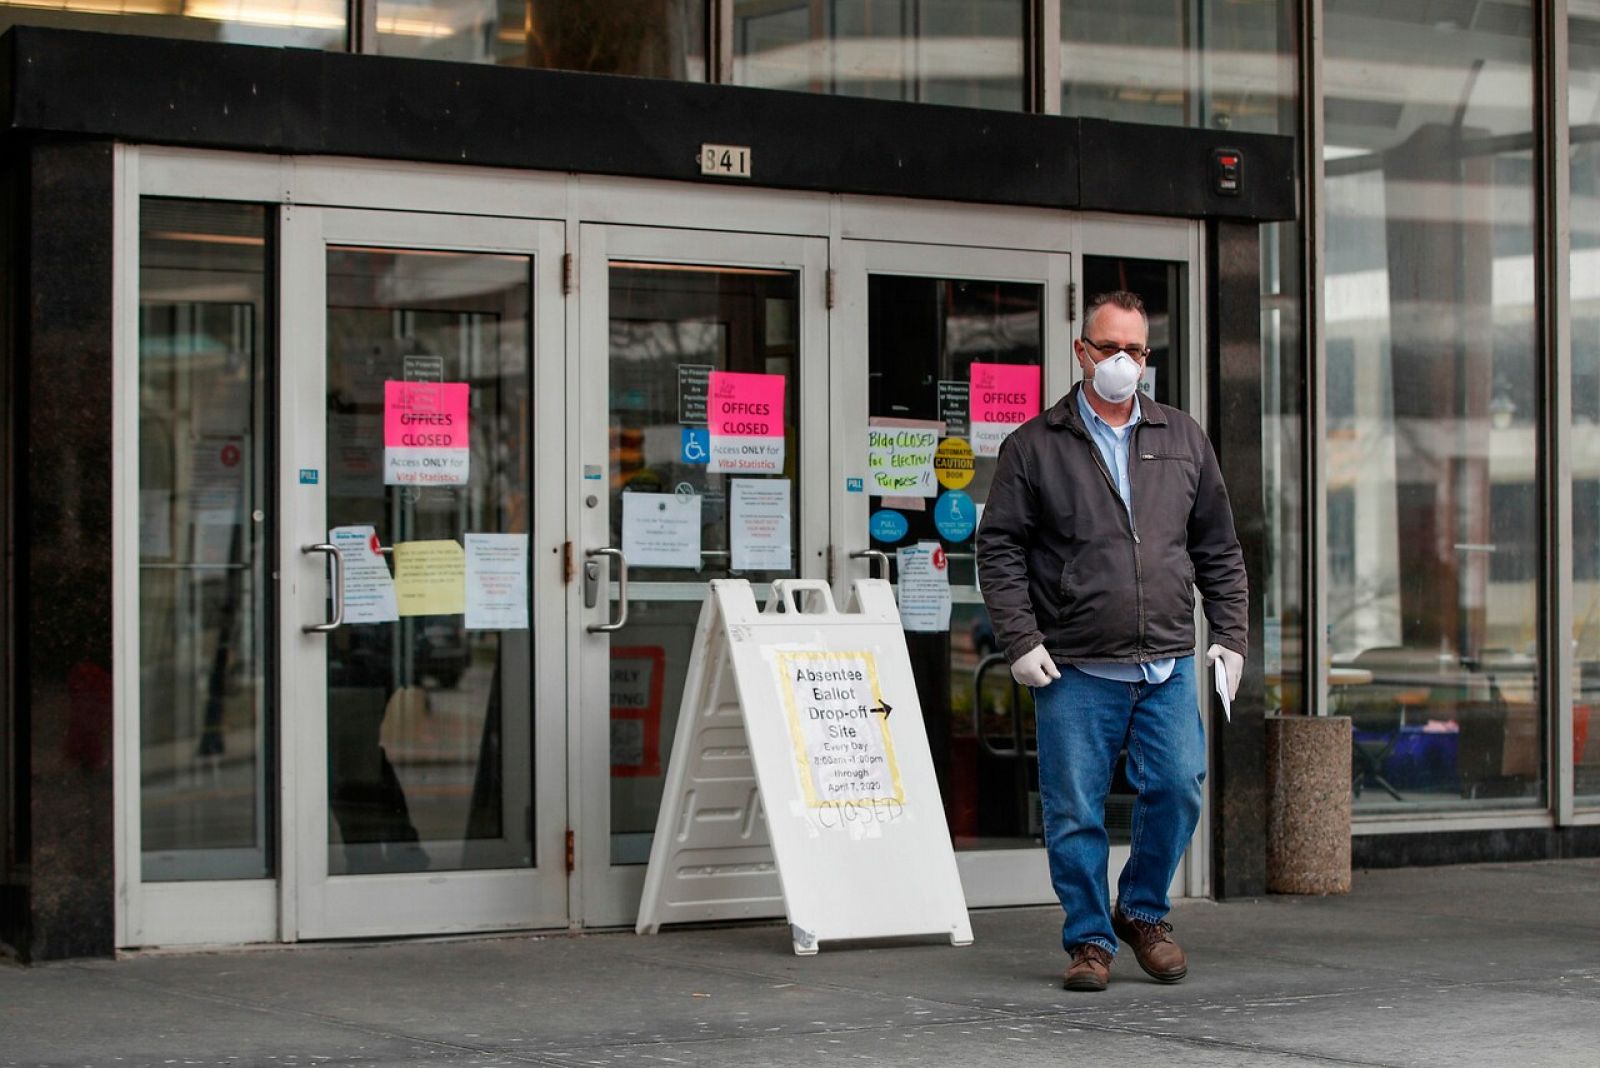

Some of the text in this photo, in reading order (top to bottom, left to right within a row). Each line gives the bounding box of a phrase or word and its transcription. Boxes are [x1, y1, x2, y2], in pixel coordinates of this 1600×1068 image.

[704, 149, 745, 174] 841
[983, 393, 1027, 405] OFFICES
[722, 402, 770, 415] OFFICES
[400, 413, 452, 426] OFFICES
[984, 411, 1026, 423] CLOSED
[723, 422, 769, 435] CLOSED
[401, 434, 452, 446] CLOSED
[896, 431, 935, 448] CLOSED
[713, 445, 780, 455] Access ONLY for
[390, 458, 463, 467] Access ONLY for
[719, 459, 776, 469] Vital Statistics
[935, 458, 974, 469] CAUTION
[396, 472, 460, 481] Vital Statistics
[796, 669, 863, 682] Absentee
[812, 688, 856, 701] Ballot
[808, 705, 869, 721] Drop-off
[829, 725, 857, 738] Site
[823, 742, 868, 753] Every Day
[834, 769, 870, 780] through
[828, 783, 849, 793] April
[860, 781, 881, 792] 2020
